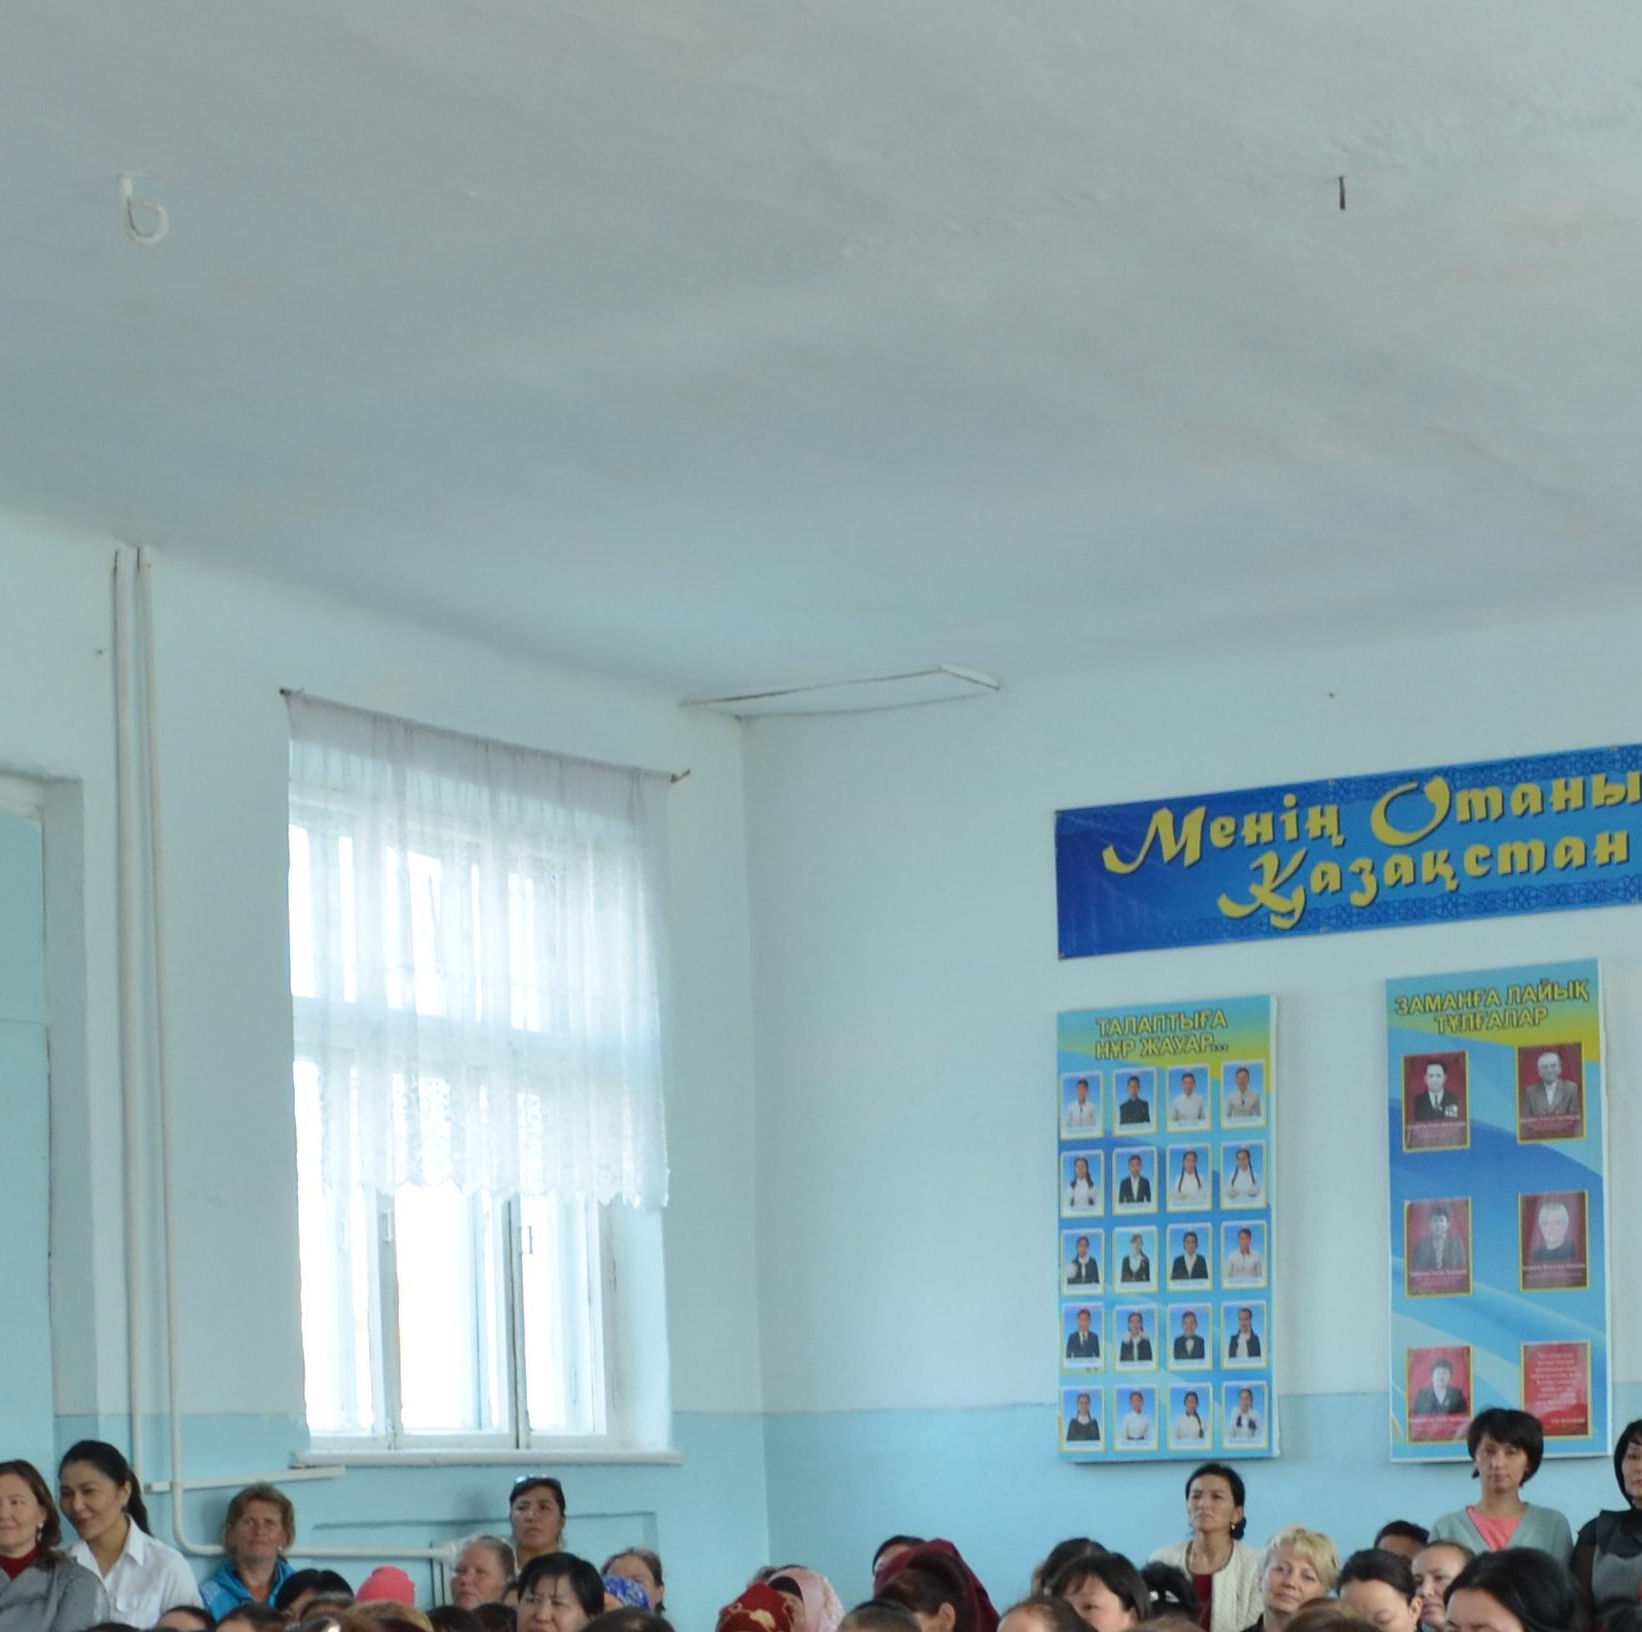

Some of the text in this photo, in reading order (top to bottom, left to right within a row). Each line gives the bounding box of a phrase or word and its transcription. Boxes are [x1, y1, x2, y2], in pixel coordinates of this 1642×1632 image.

[1102, 794, 1345, 875] Менің
[1217, 828, 1630, 929] Қазақстан
[1395, 978, 1590, 1016] ЗАМАНҒА ЛАЙЫҚ
[1096, 1009, 1228, 1037] ТАЛАПТЫҒА
[1435, 1006, 1549, 1034] ТҰЛҒАЛАР
[1095, 1038, 1136, 1061] НҰР
